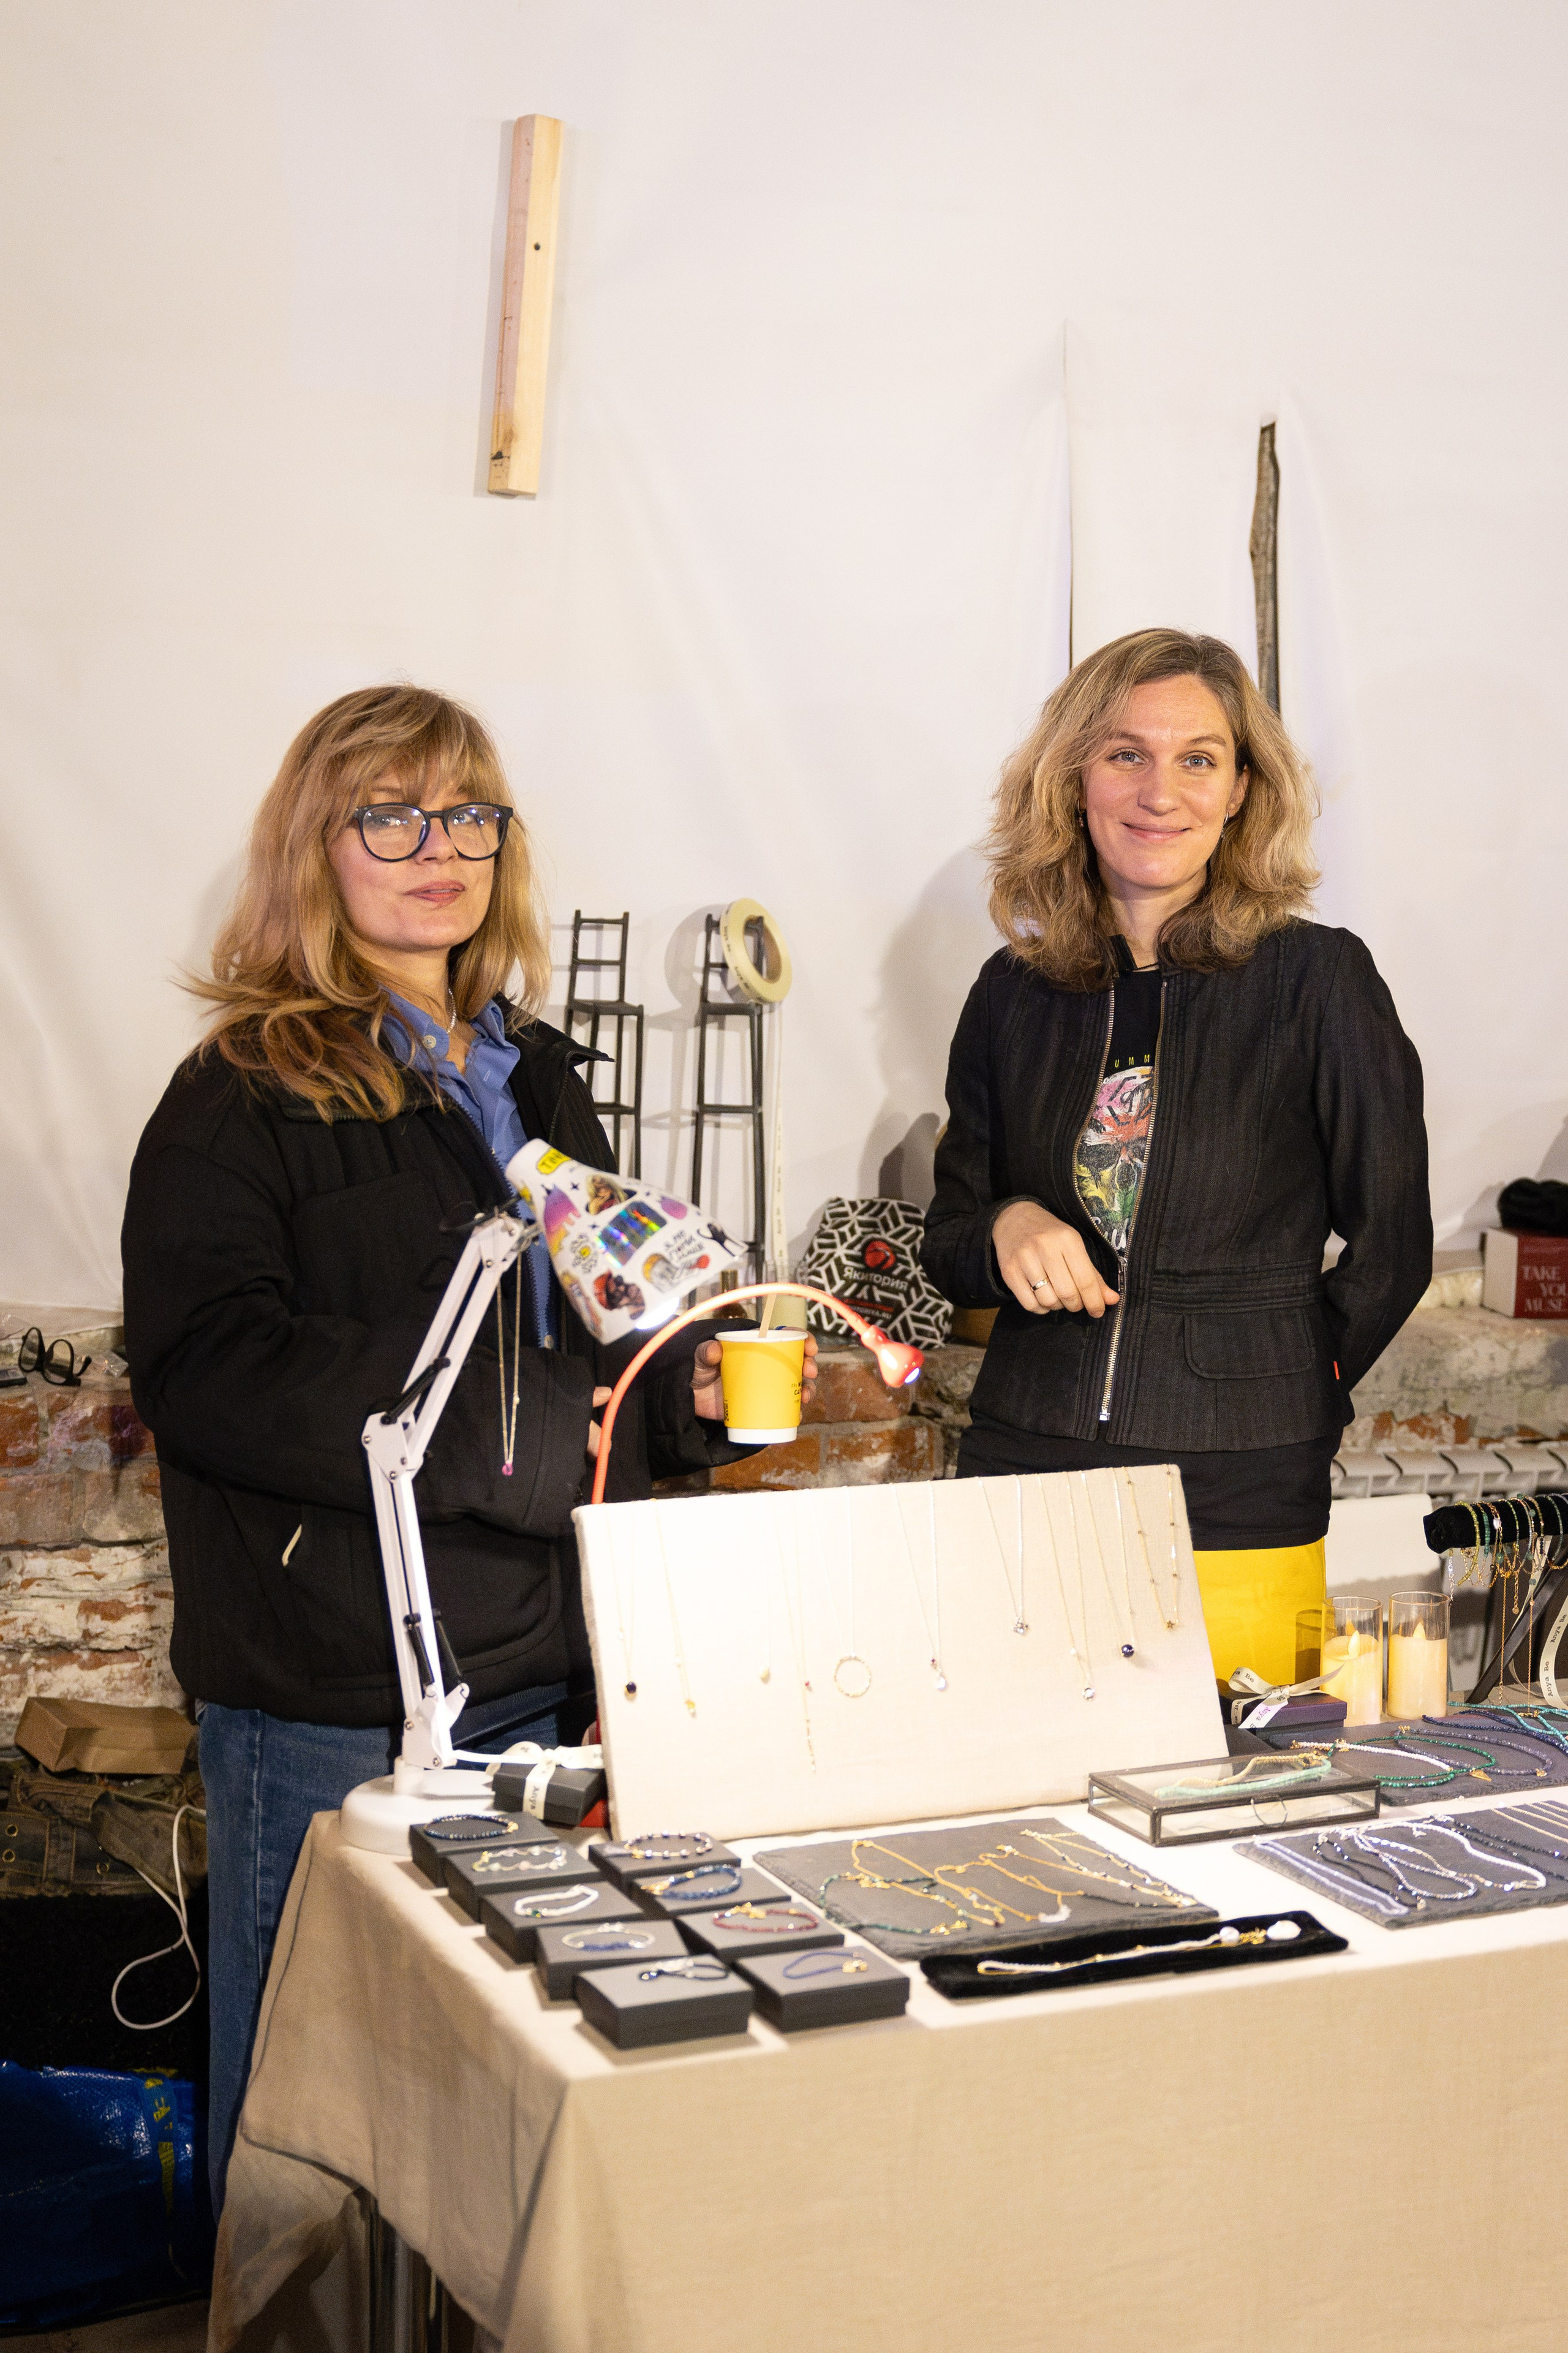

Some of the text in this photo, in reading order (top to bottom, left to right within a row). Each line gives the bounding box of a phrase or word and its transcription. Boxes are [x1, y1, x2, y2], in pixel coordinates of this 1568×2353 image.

[843, 1266, 908, 1291] Якитория
[1521, 1265, 1562, 1280] TAKE
[1550, 1614, 1567, 1644] Anya Be
[1544, 1660, 1550, 1672] Be
[1256, 1707, 1270, 1721] Anya
